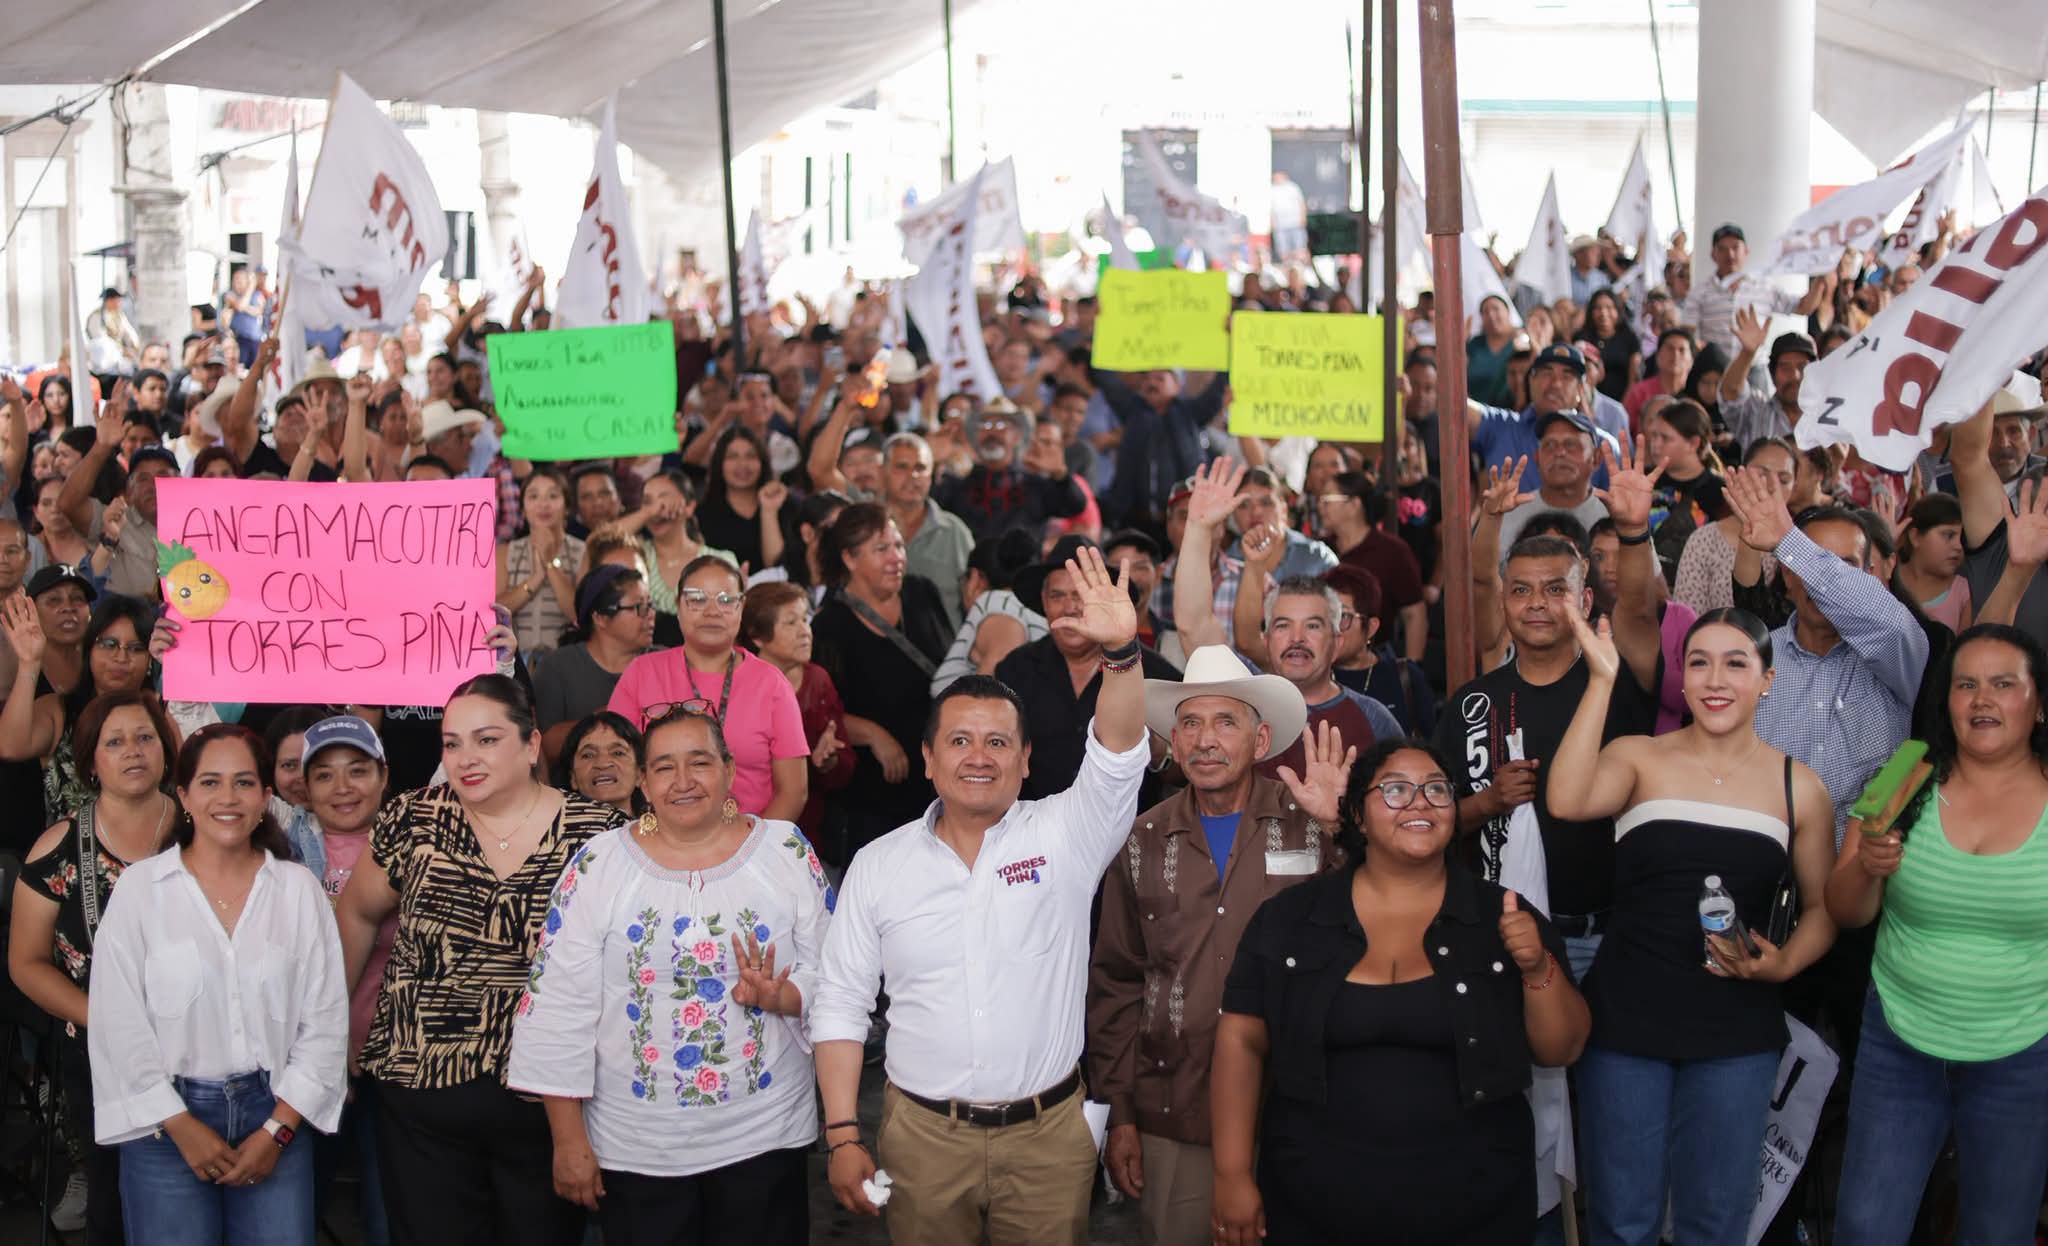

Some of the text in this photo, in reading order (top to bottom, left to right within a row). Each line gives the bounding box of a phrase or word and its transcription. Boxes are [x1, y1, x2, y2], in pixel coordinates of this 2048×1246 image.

[261, 569, 347, 613] CON
[190, 600, 498, 676] TORRES PIÑA
[997, 856, 1047, 879] TORRES
